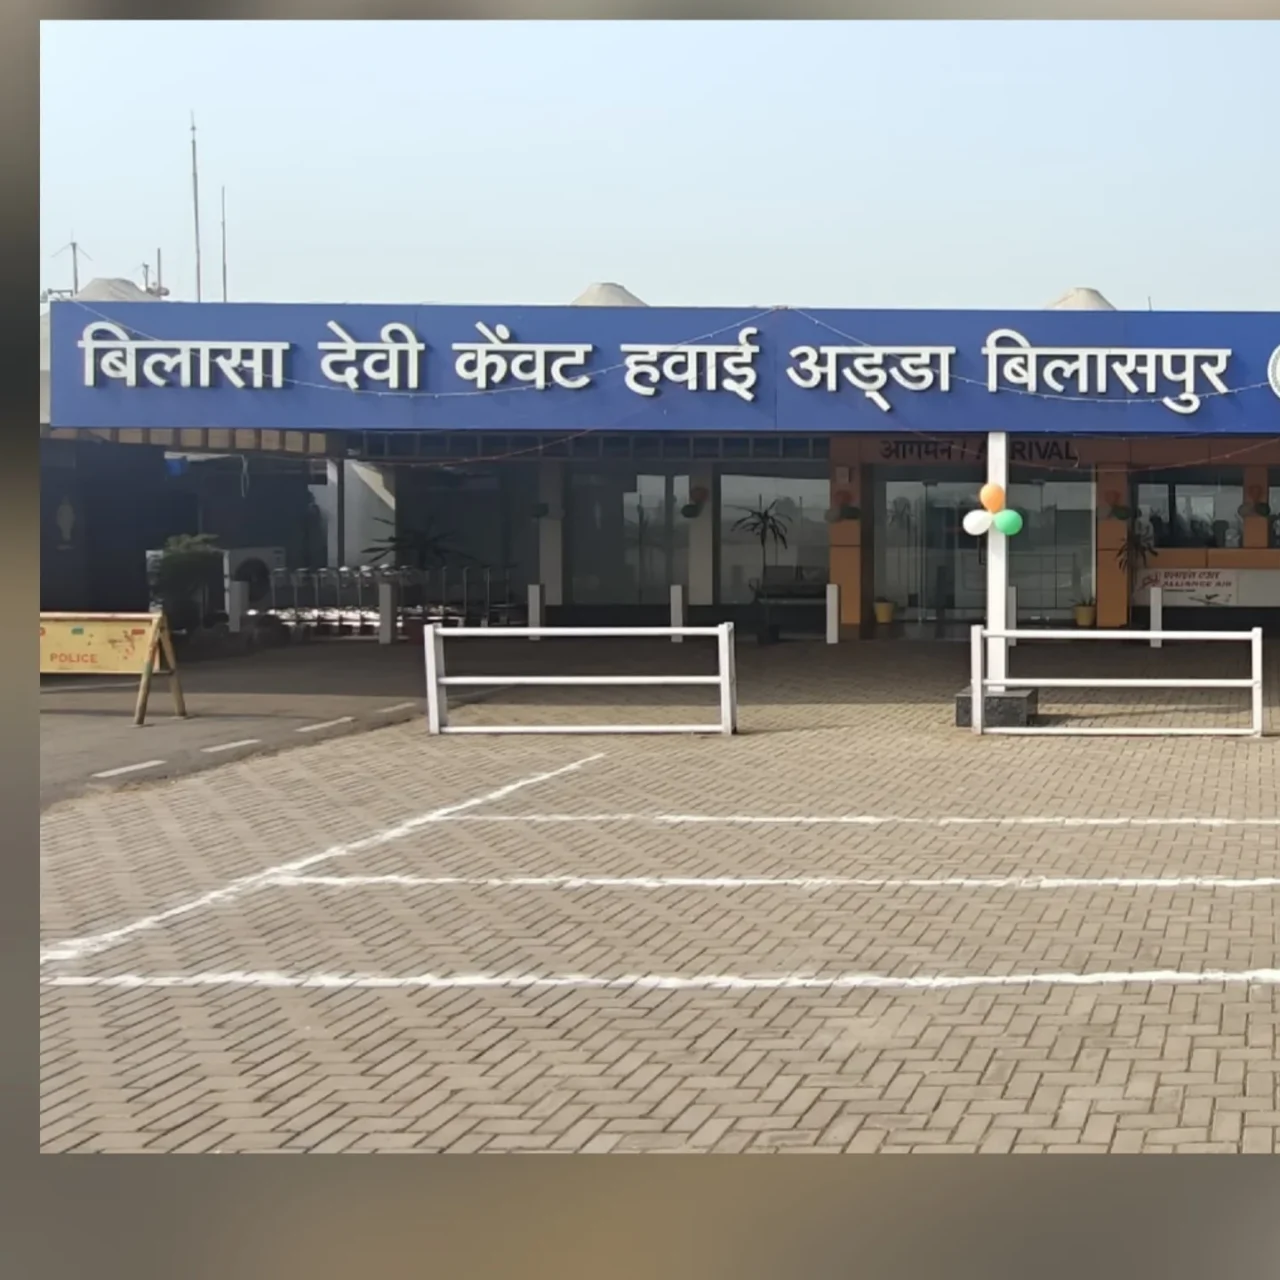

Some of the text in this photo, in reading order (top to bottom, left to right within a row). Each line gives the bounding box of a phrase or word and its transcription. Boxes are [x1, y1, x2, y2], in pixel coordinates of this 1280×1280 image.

[77, 321, 290, 388] बिलासा
[317, 320, 425, 390] देवी
[620, 326, 760, 401] हवाई
[786, 345, 956, 412] अड्डा
[981, 328, 1232, 414] बिलासपुर
[880, 439, 954, 460] आगमन
[976, 439, 1078, 461] ARIVAL
[50, 652, 99, 664] POLICE
